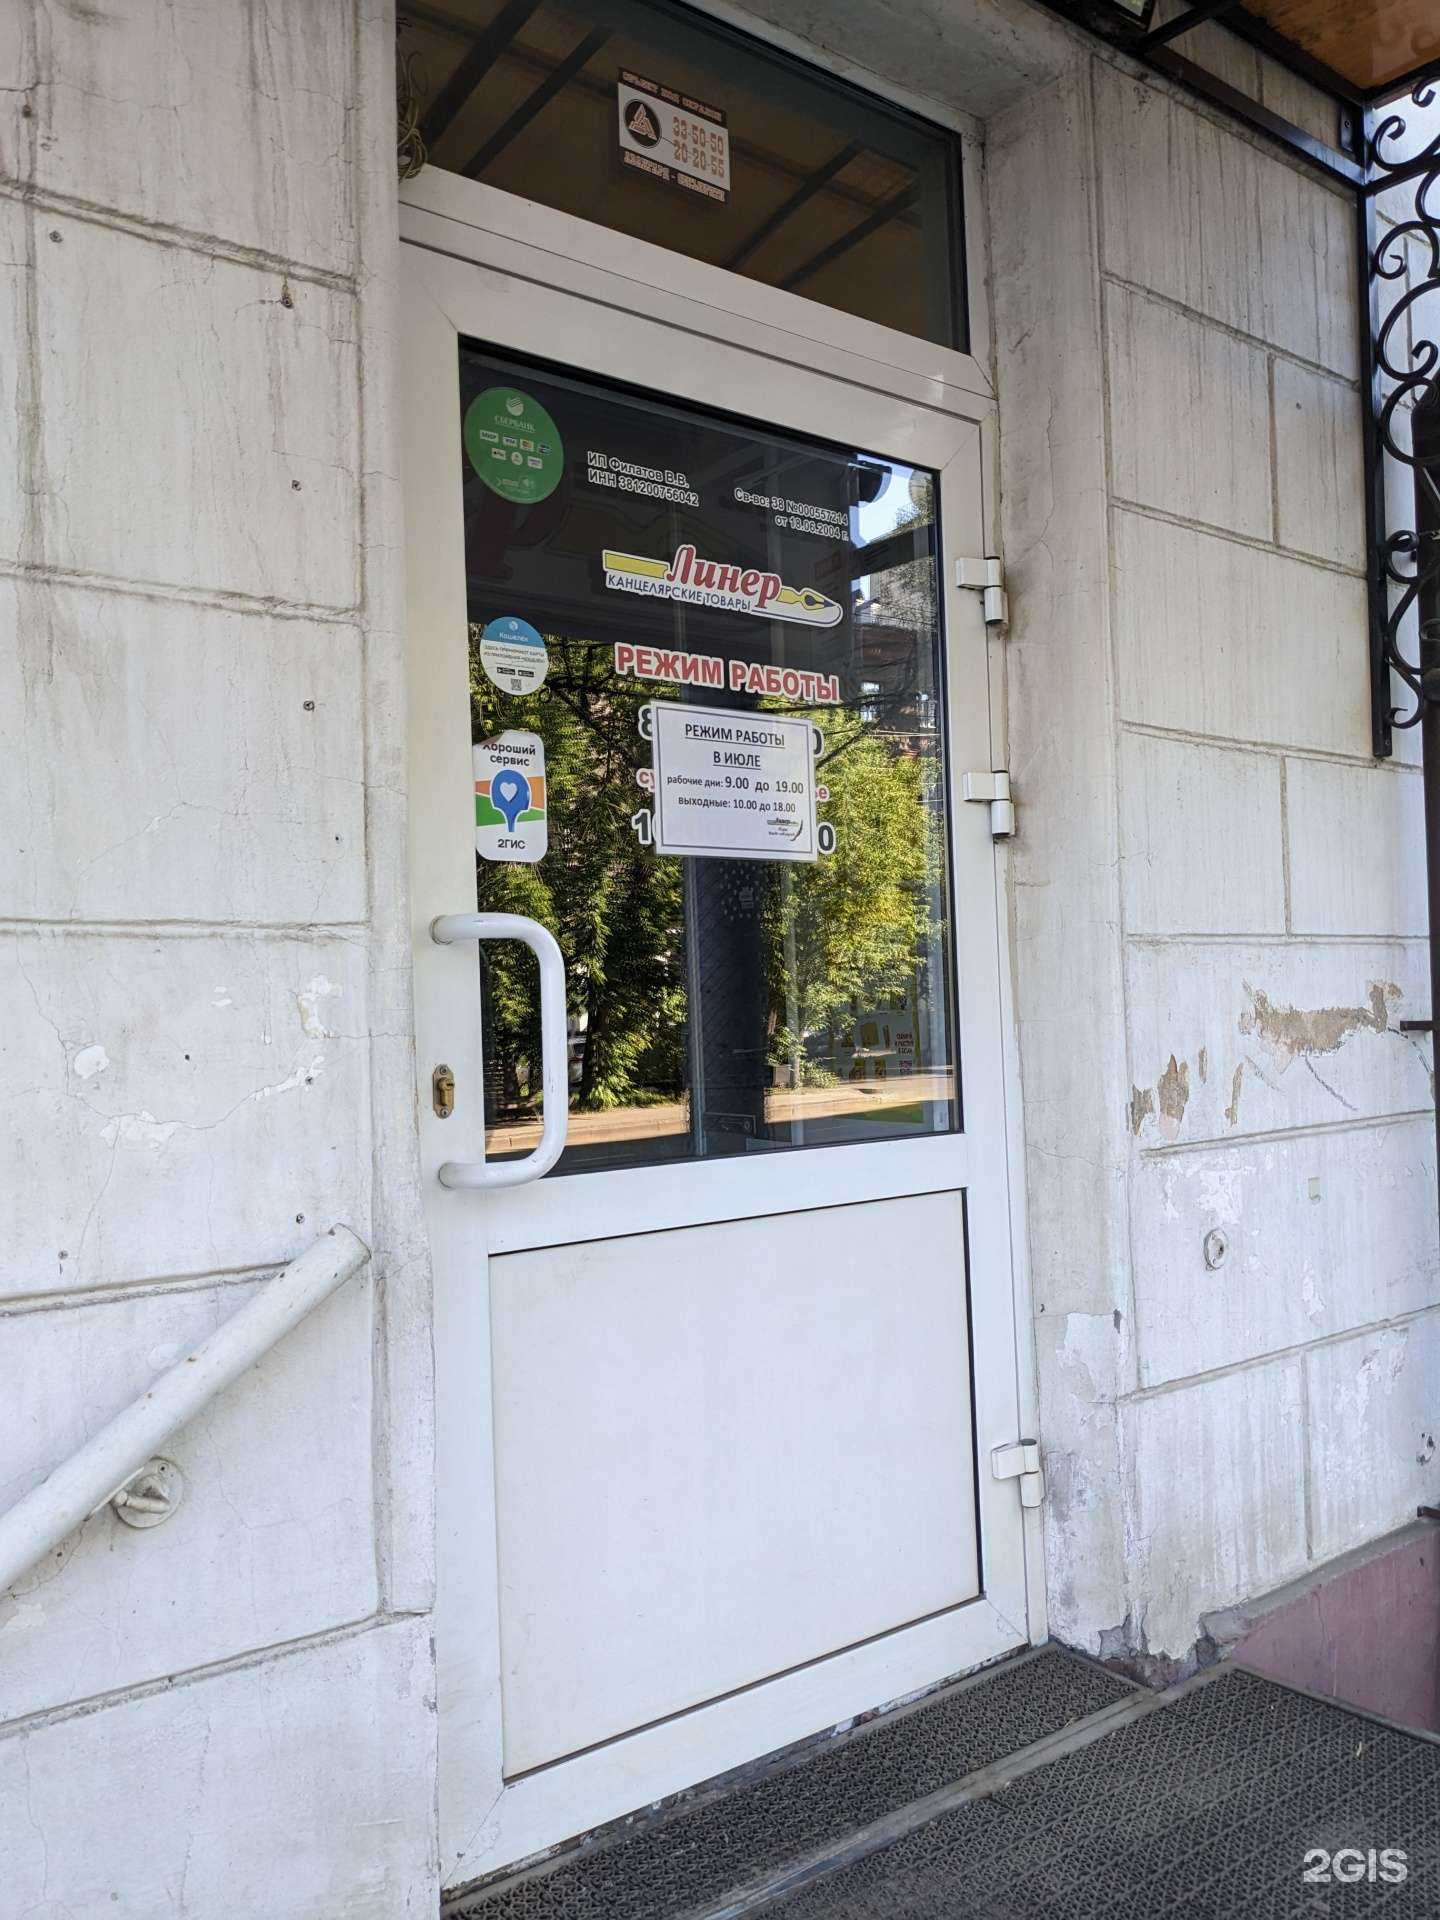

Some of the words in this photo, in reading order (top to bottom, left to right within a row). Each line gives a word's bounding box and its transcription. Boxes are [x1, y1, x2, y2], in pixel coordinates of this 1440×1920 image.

[588, 451, 607, 469] ИП
[609, 457, 663, 482] Филатов
[665, 470, 690, 489] В.В.
[588, 468, 617, 488] ИНН
[618, 476, 700, 507] 381200756042
[734, 487, 770, 508] Св-во:
[771, 496, 785, 511] 38
[775, 515, 788, 527] от
[667, 545, 781, 609] Линер
[608, 574, 703, 601] КАНЦЕЛЯРСКИЕ
[704, 592, 751, 612] ТОВАРЫ
[616, 644, 724, 688] РЕЖИМ
[730, 660, 840, 701] РАБОТЫ
[684, 723, 733, 742] РЕЖИМ
[736, 731, 785, 747] РАБОТЫ
[490, 755, 530, 767] сервис
[713, 751, 722, 764] В
[724, 753, 761, 768] ИЮЛЕ
[667, 775, 703, 786] рабочие
[704, 778, 724, 789] дни:
[725, 776, 750, 790] 9.00
[755, 781, 770, 794] до
[776, 780, 804, 794] 19.00
[678, 796, 731, 809] выходные:
[733, 799, 758, 811] 10.00
[759, 802, 771, 812] до
[773, 801, 796, 813] 18.00
[498, 838, 526, 850] 2ГИС
